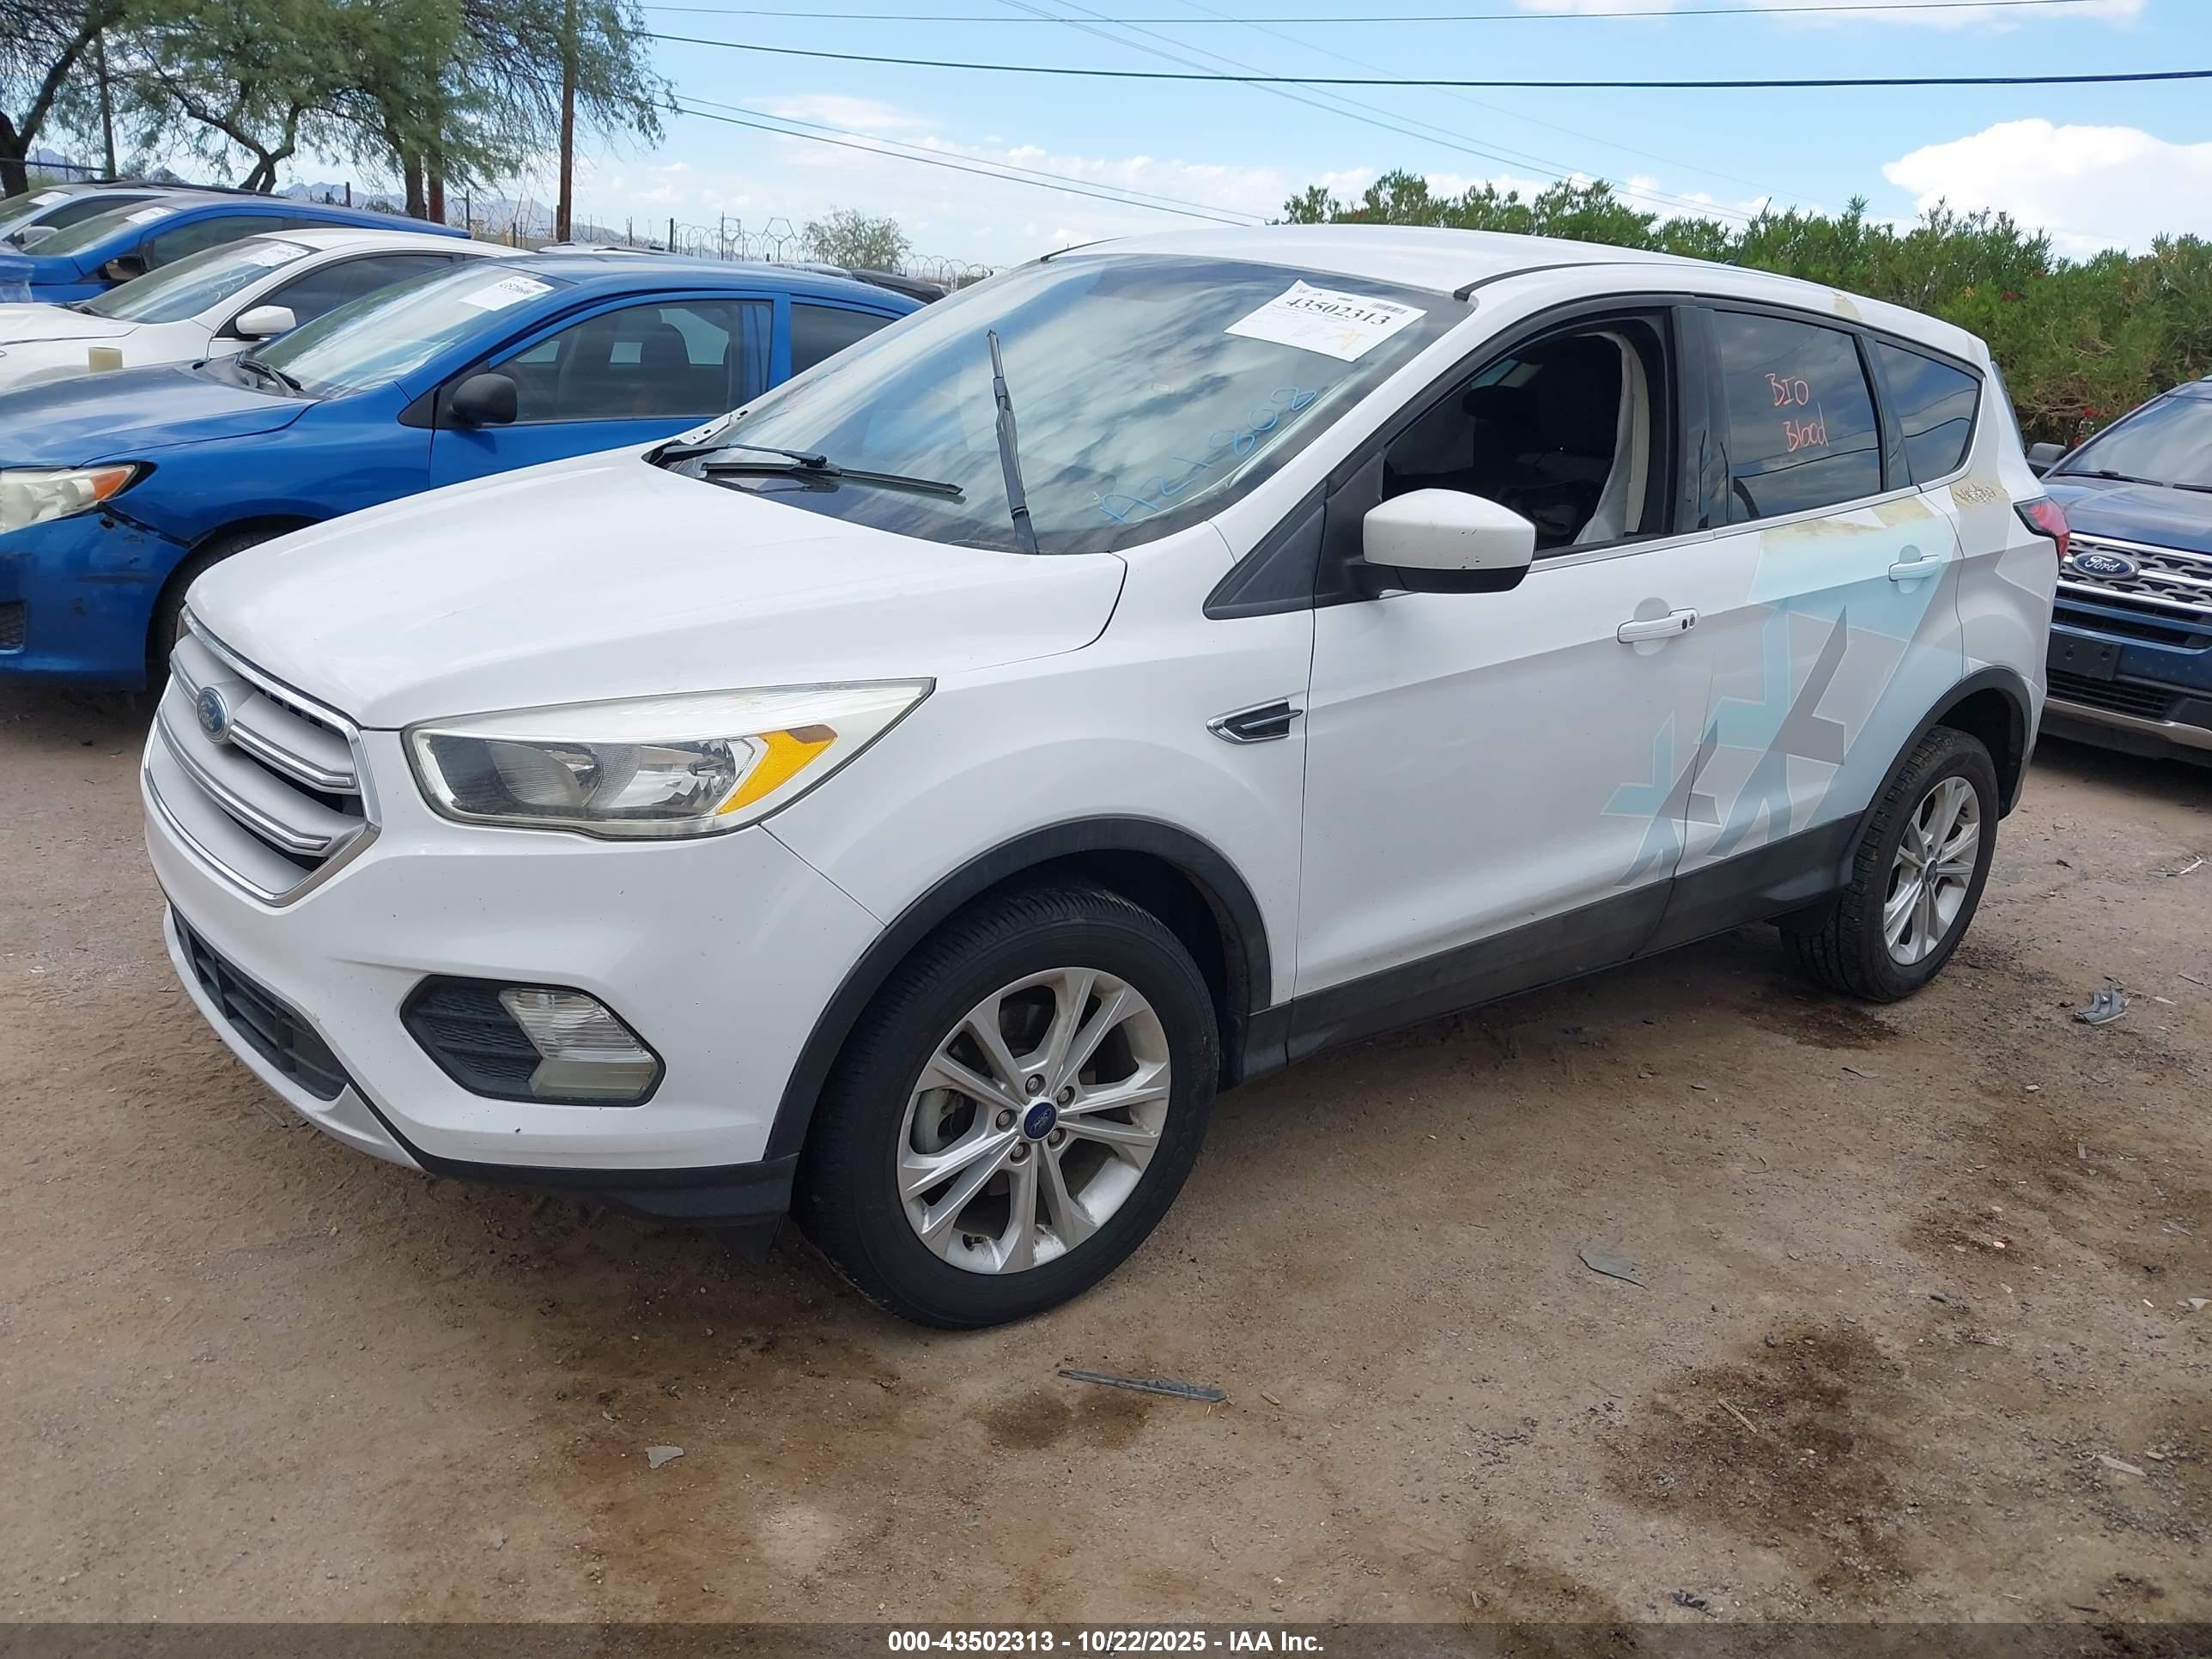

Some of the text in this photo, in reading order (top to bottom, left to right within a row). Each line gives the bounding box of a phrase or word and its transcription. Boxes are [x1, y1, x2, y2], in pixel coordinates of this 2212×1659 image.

[1285, 297, 1392, 325] 43502313
[1765, 373, 1809, 406] BIO
[1783, 402, 1829, 453] Blood
[2085, 556, 2120, 572] Ford
